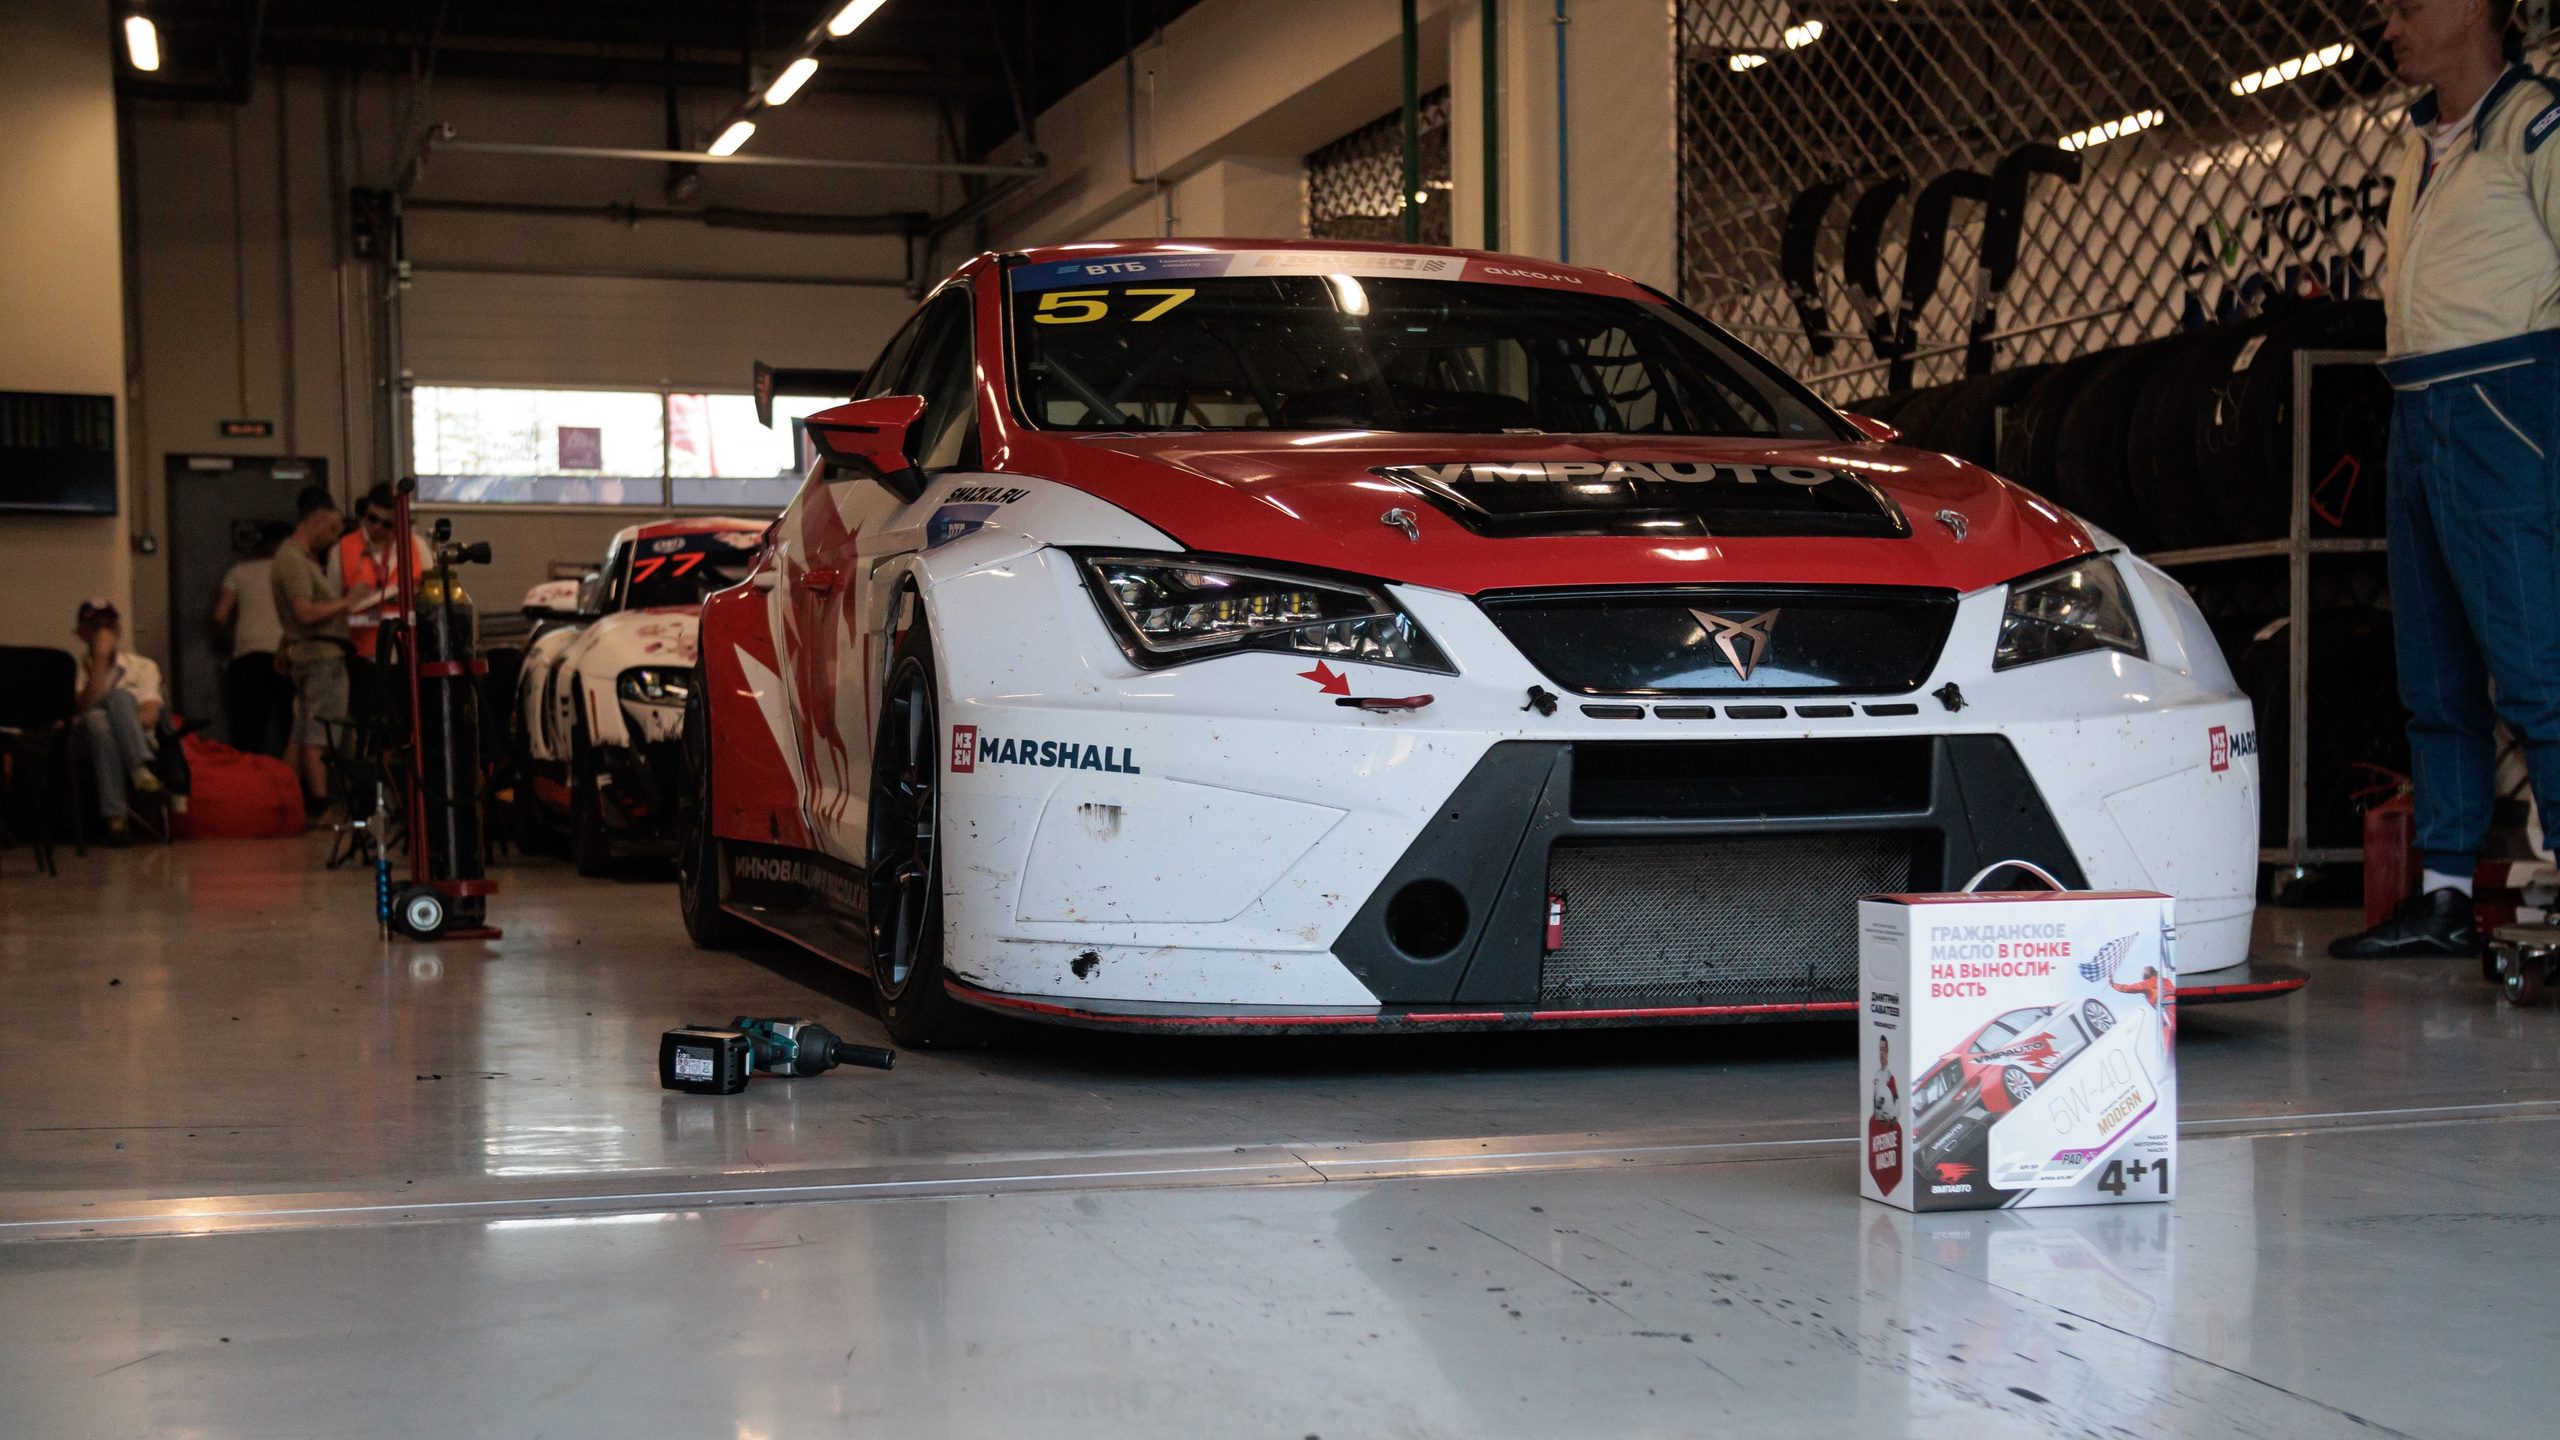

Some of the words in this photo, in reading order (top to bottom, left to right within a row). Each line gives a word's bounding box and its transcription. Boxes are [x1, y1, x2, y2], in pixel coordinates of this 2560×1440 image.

[1085, 261, 1147, 276] ВТБ
[1484, 265, 1582, 285] auto.ru
[1033, 288, 1197, 325] 57
[1408, 461, 1836, 487] VMPAUTO
[944, 486, 1031, 504] SMAZKA.RU
[633, 552, 706, 584] 77
[978, 736, 1141, 775] MARSHALL
[1931, 923, 2066, 943] ГРАЖДАНСКОЕ
[1931, 943, 1995, 961] МАСЛО
[1998, 943, 2010, 958] В
[2013, 941, 2071, 958] ГОНКЕ
[1931, 963, 1956, 979] НА
[1959, 960, 2057, 978] ВЫНОСЛИ-
[1931, 982, 1988, 998] ВОСТЬ
[2048, 1048, 2132, 1135] 5W-40
[2096, 1089, 2143, 1136] MODERN
[2062, 1153, 2083, 1166] PAO
[2097, 1158, 2168, 1196] 4+1
[1931, 1183, 1972, 1194] ВМПАВТО
